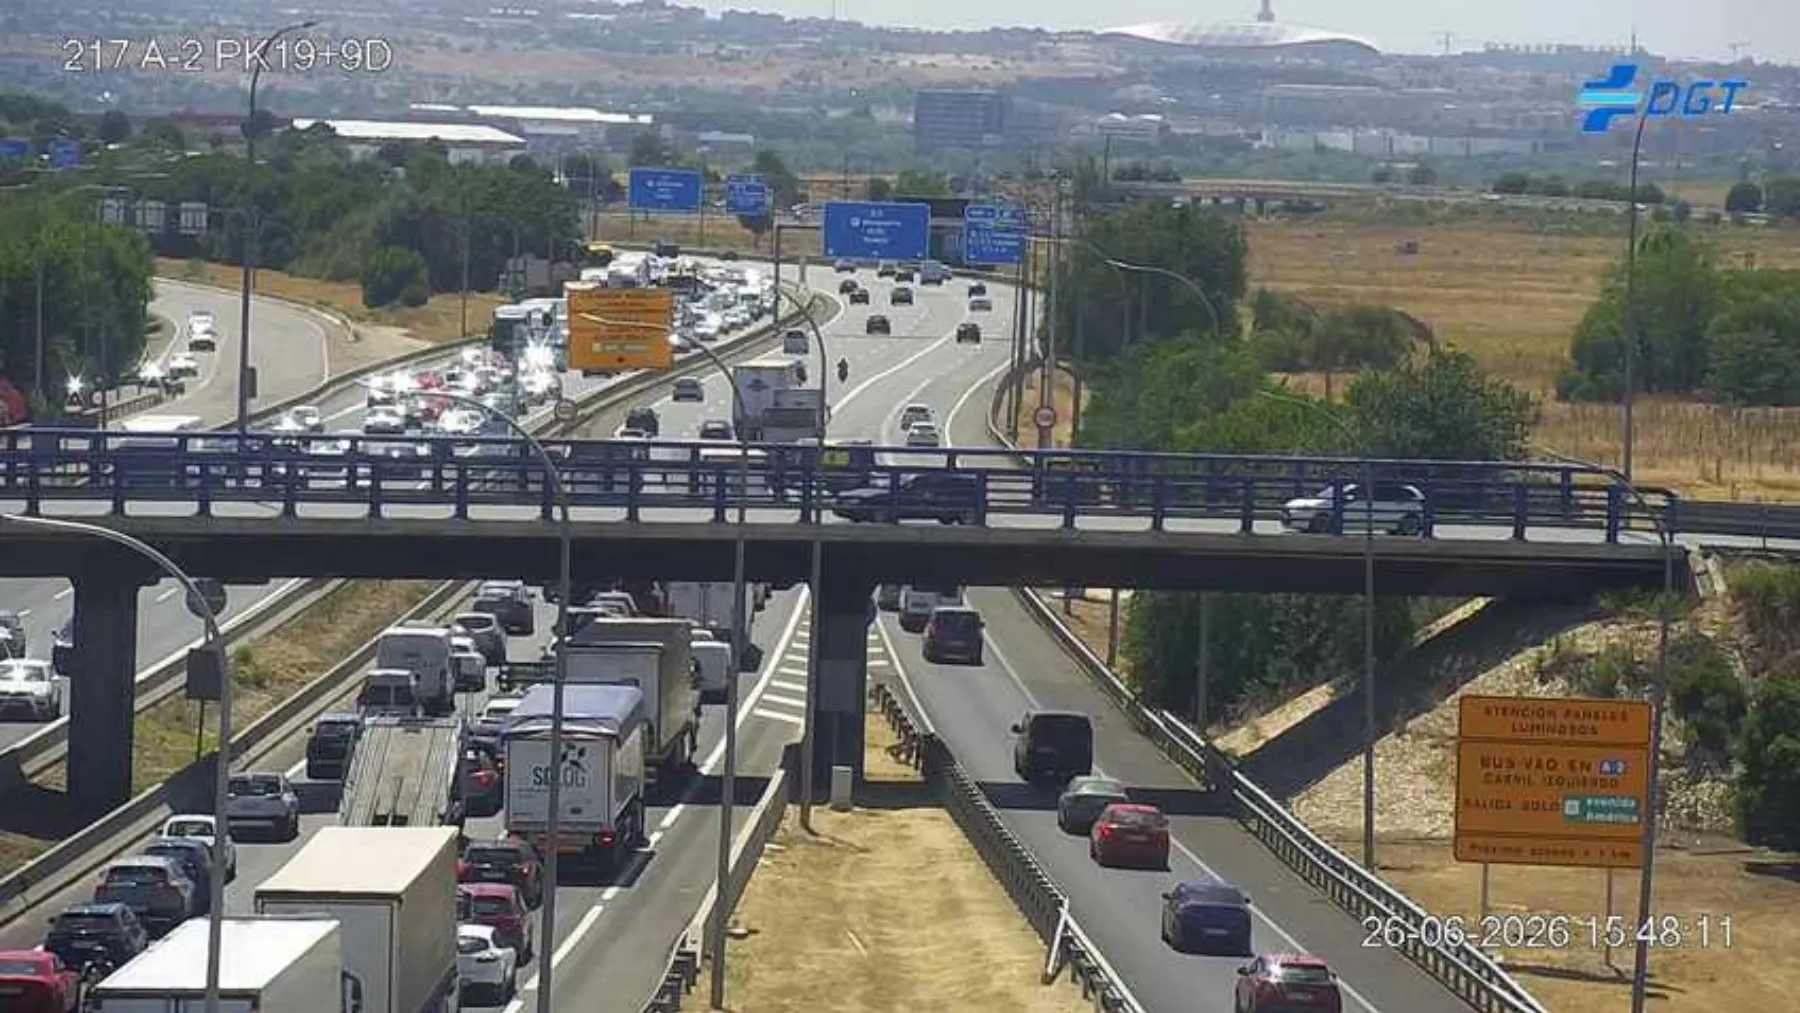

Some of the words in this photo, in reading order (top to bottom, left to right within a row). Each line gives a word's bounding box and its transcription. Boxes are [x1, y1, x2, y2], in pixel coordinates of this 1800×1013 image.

[1569, 759, 1592, 772] EN
[533, 765, 586, 789] SOOG
[1522, 799, 1561, 811] SOLO
